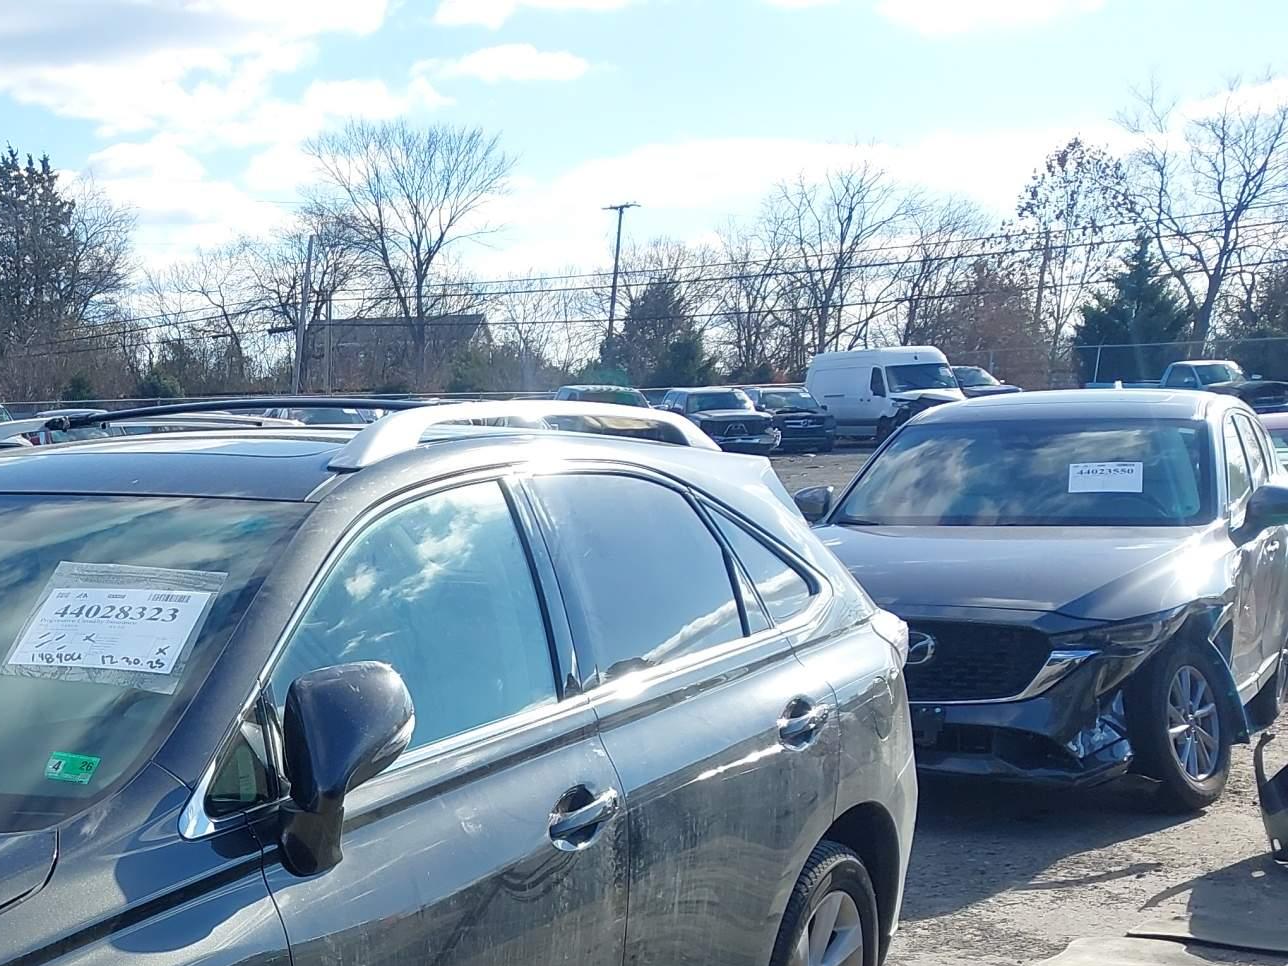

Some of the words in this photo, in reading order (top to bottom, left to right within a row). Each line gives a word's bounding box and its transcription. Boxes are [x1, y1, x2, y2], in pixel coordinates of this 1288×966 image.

[54, 604, 180, 623] 44028323
[52, 760, 62, 771] 4
[80, 760, 94, 771] 26
